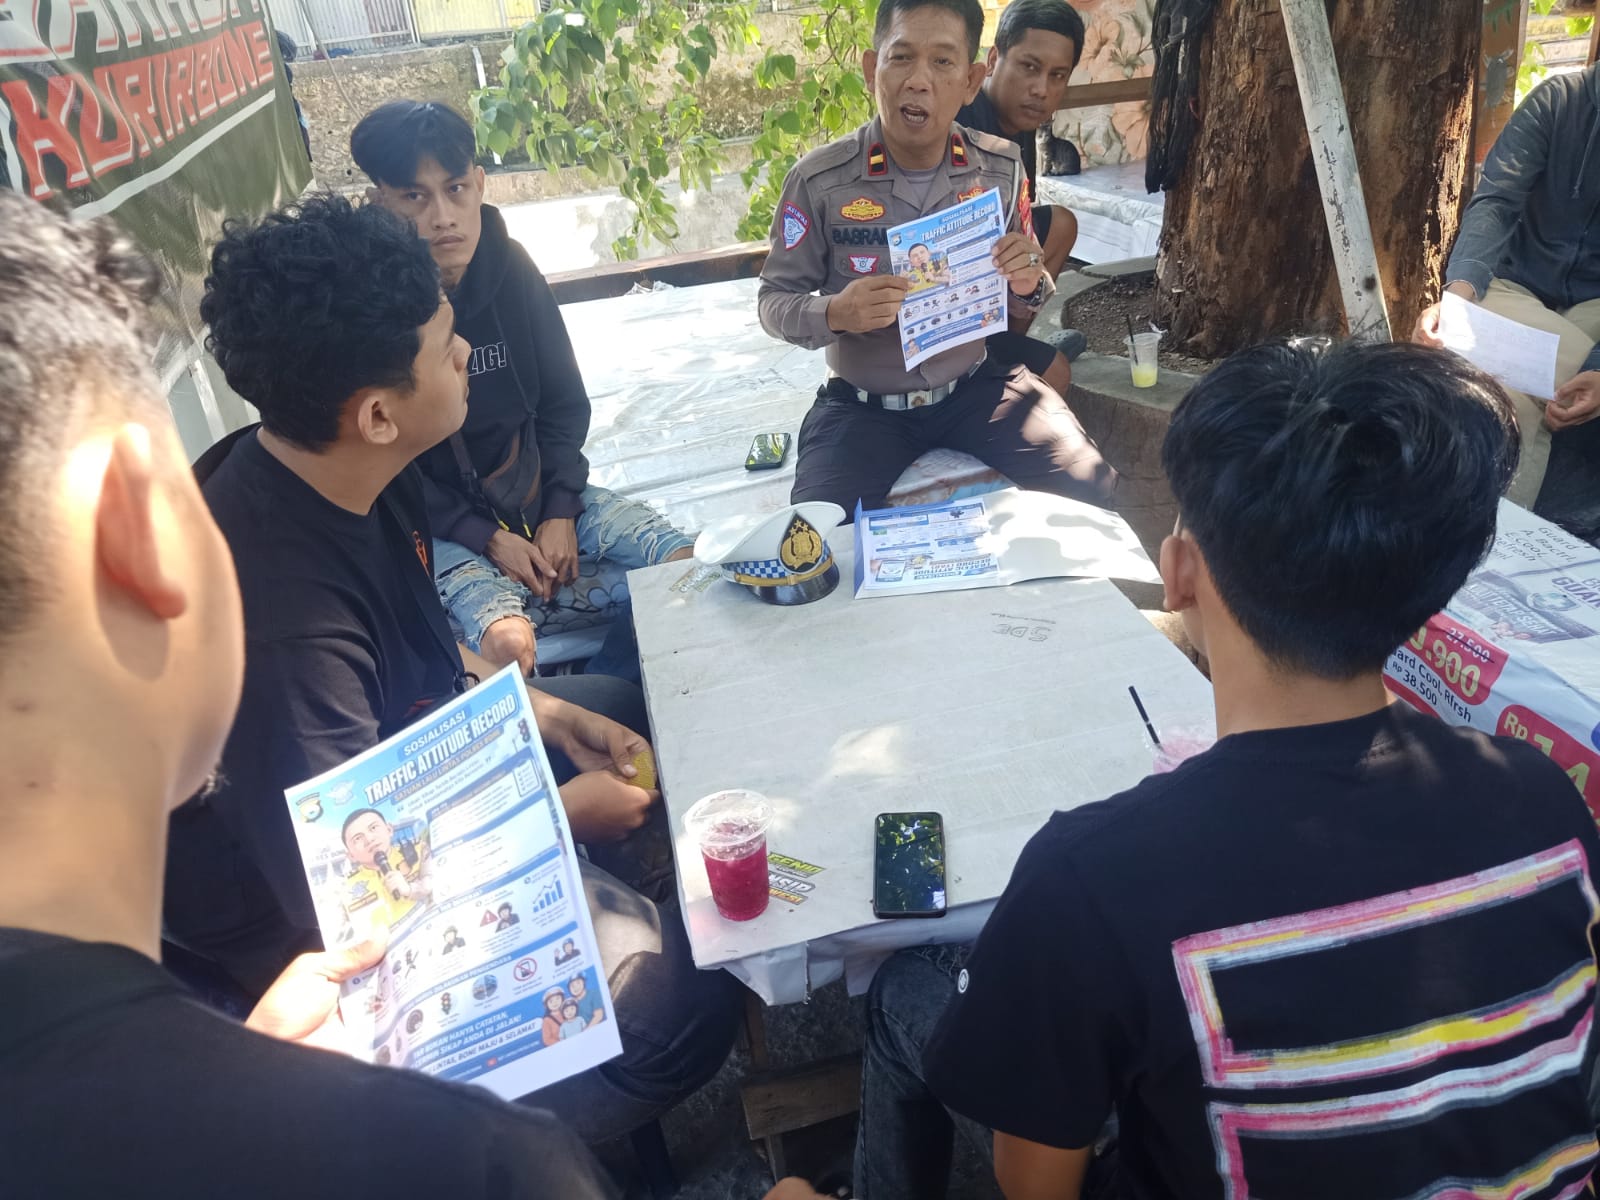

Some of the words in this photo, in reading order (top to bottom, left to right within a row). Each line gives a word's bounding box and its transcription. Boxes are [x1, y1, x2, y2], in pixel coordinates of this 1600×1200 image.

[921, 225, 946, 242] TRAFFIC
[946, 215, 974, 233] ATTITUDE
[1538, 527, 1578, 551] Guard
[1447, 627, 1490, 663] 27.500
[1392, 661, 1402, 673] Rp
[1403, 670, 1437, 706] 38.500
[1419, 664, 1443, 696] Cool,
[404, 710, 466, 756] SOSIALISASI
[1503, 711, 1528, 740] Rp
[365, 761, 416, 805] TRAFFIC
[417, 724, 472, 774] ATTITUDE
[470, 693, 517, 739] RECORD
[449, 1026, 475, 1041] HANYA
[463, 1031, 484, 1046] ANDA
[485, 1026, 495, 1036] DI
[505, 1022, 536, 1041] SELAMAT
